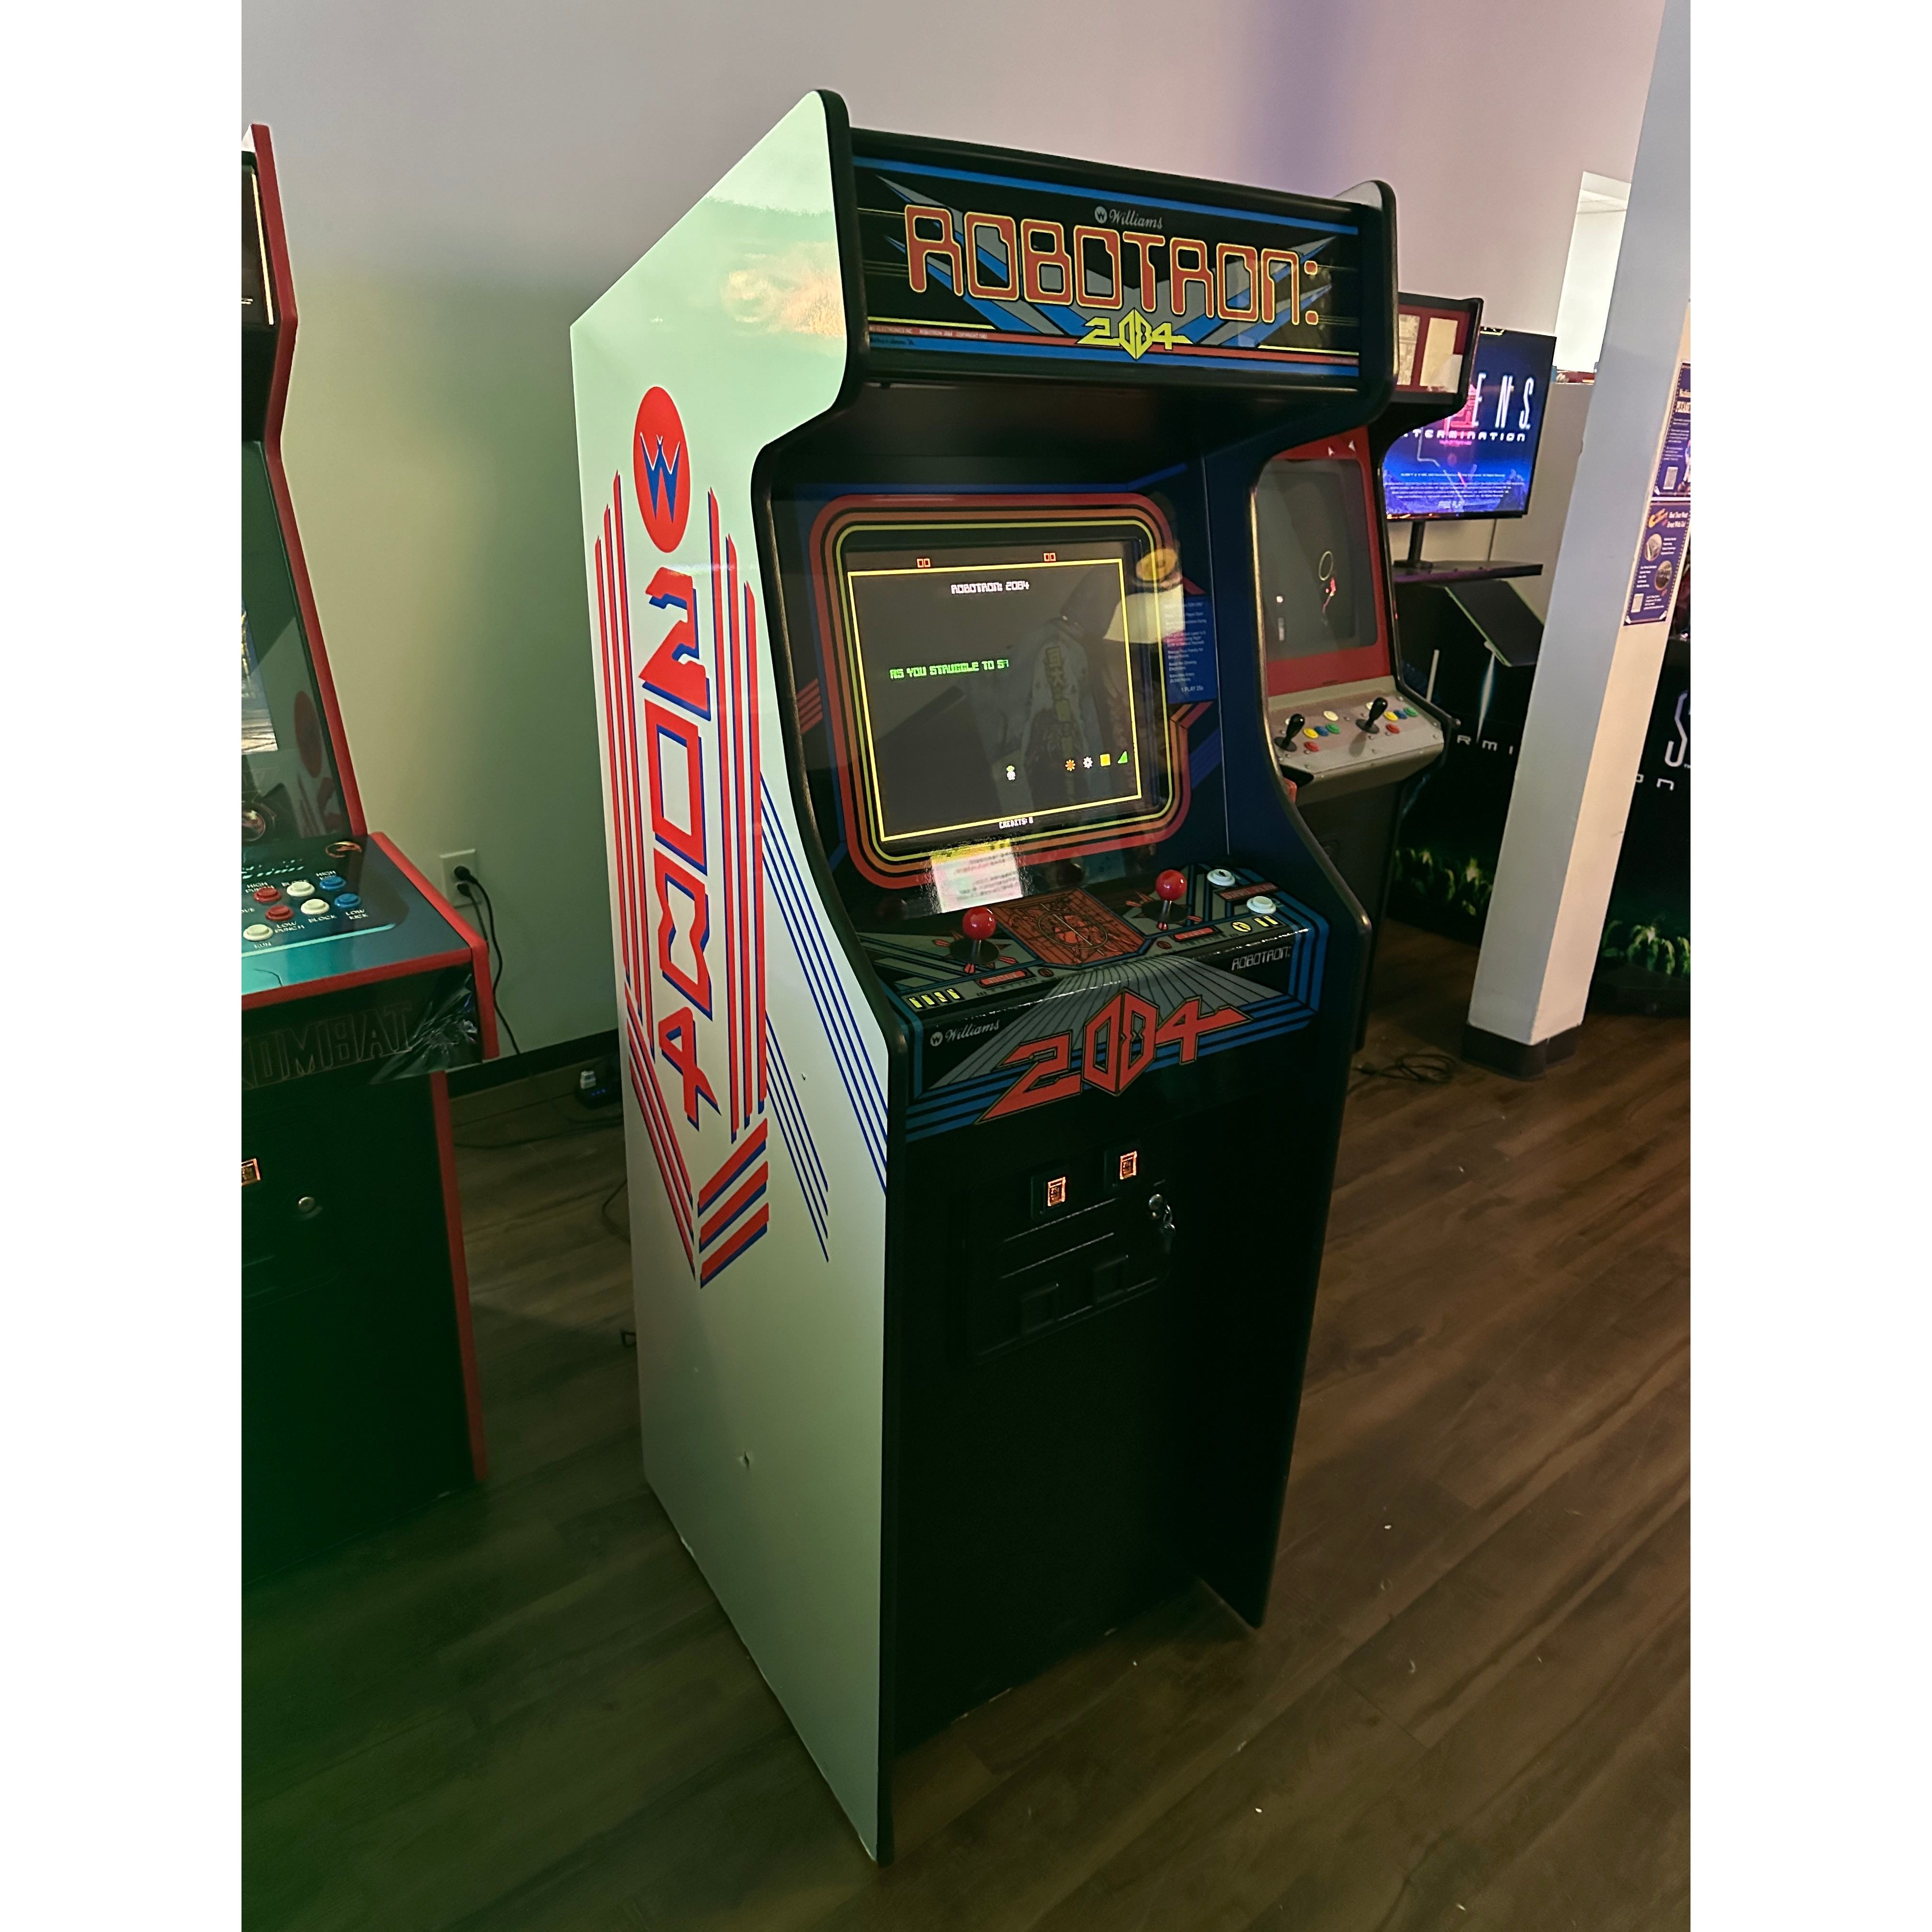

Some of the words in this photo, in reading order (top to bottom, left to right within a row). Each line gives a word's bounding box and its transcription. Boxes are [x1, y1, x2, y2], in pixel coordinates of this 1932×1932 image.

[1109, 208, 1163, 230] Williams
[1403, 428, 1526, 442] TERMINATION
[1005, 580, 1030, 591] 2084
[890, 669, 905, 679] AS
[906, 667, 927, 678] YOU
[930, 662, 979, 676] STRUGGLE
[981, 660, 995, 670] TO
[308, 915, 337, 923] BLOCK
[275, 925, 305, 933] PUNCH
[945, 1019, 1000, 1042] Williams
[242, 1000, 413, 1090] OMBAT
